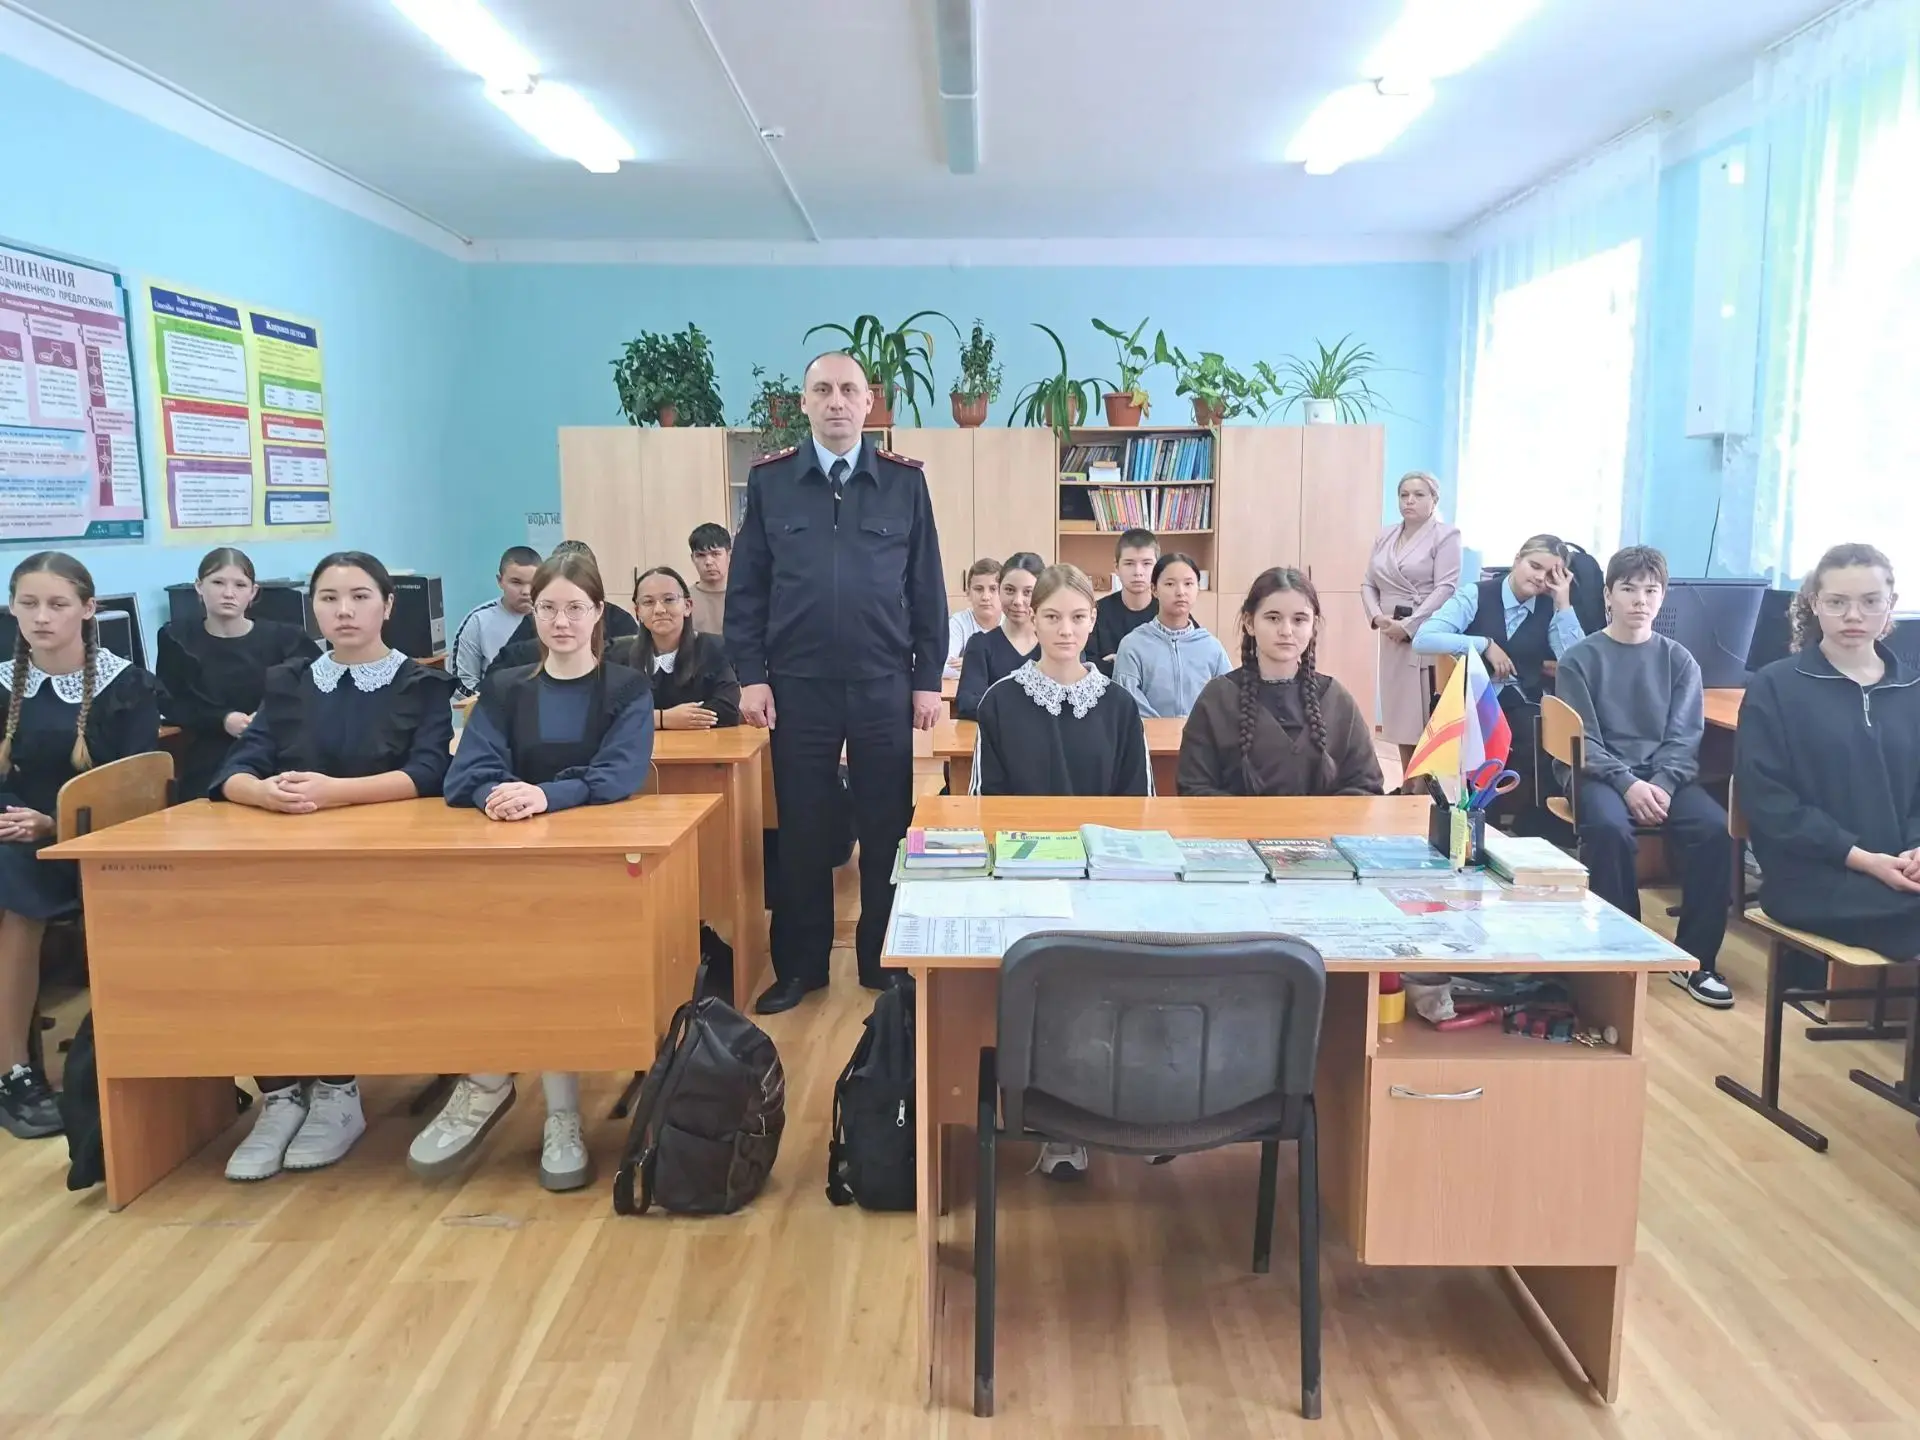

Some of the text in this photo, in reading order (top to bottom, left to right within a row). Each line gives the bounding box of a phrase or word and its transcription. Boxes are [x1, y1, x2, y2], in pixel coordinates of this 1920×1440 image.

[59, 290, 113, 310] ПРЕДЛОЖЕНИЯ
[527, 514, 549, 526] ВОДА
[1006, 840, 1038, 859] 7
